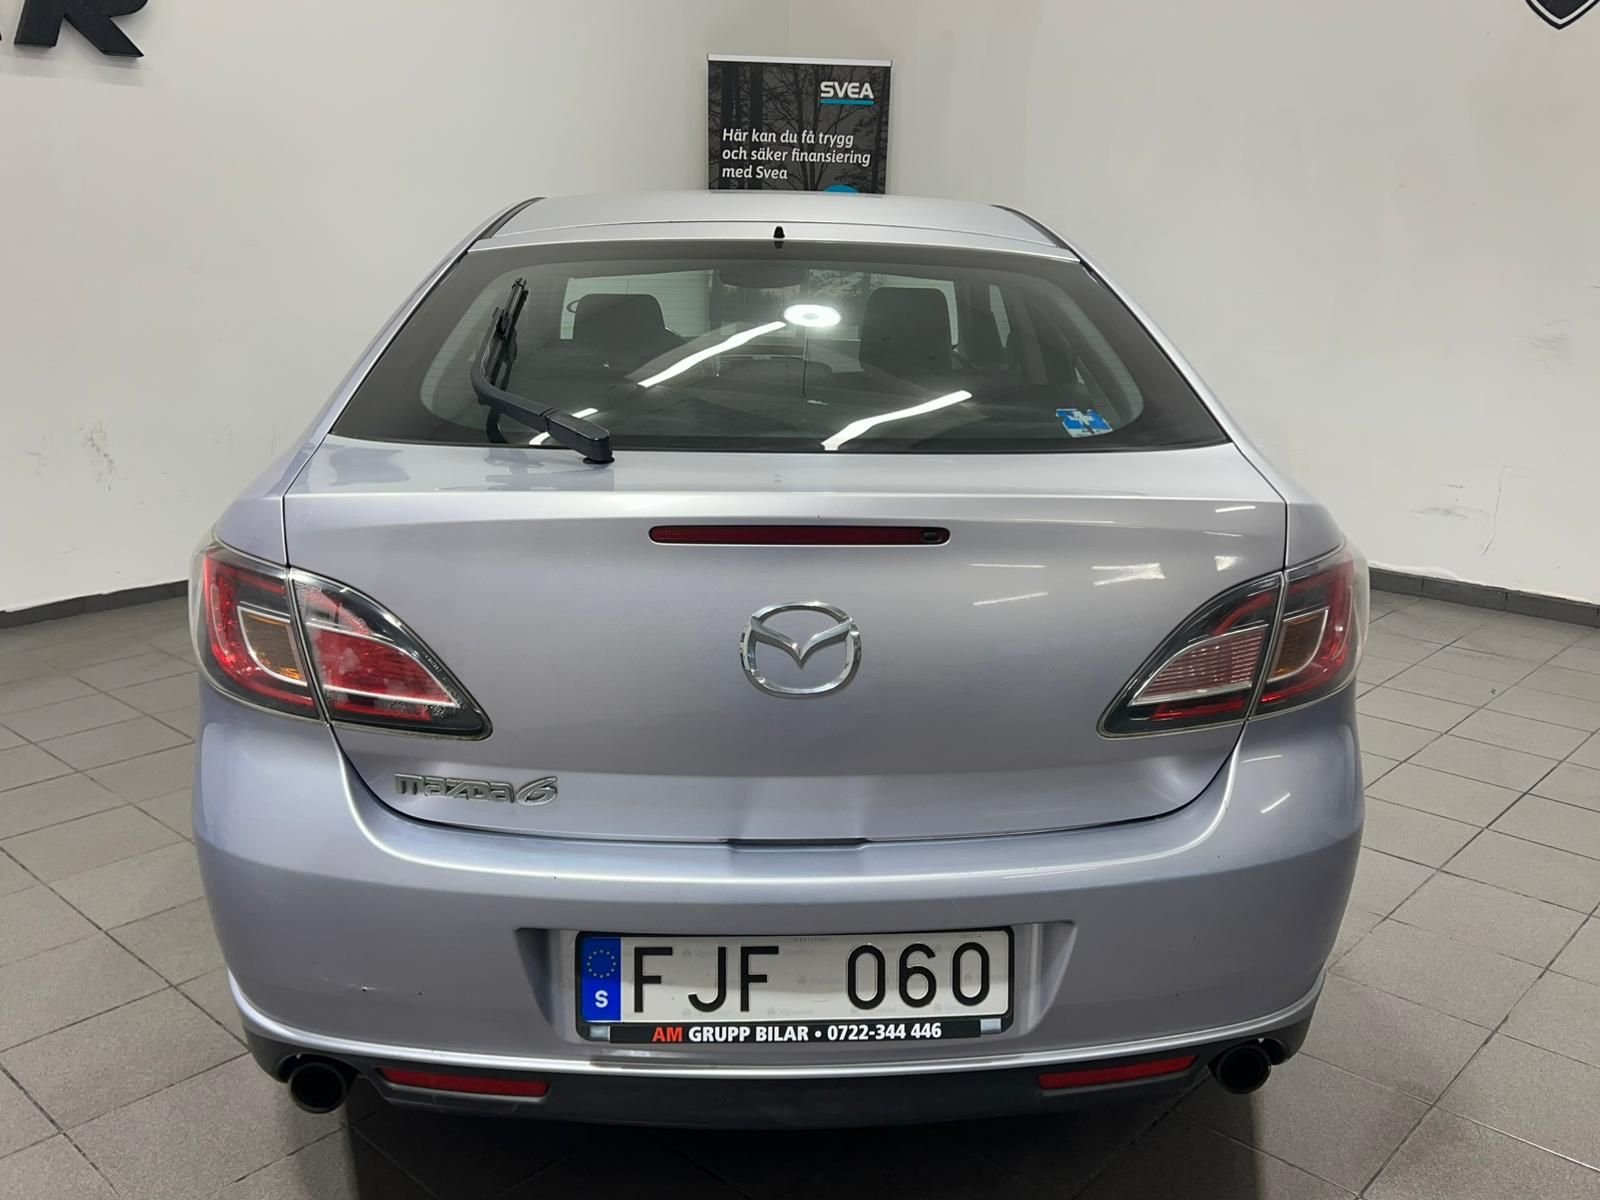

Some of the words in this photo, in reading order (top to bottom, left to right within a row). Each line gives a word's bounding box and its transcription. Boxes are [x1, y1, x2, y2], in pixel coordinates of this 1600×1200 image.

[820, 81, 875, 99] SVEA
[722, 128, 748, 142] Här
[751, 129, 777, 143] kan
[780, 130, 798, 144] du
[801, 130, 815, 145] få
[818, 132, 854, 148] trygg
[722, 147, 748, 160] och
[751, 148, 788, 162] säker
[791, 149, 871, 167] finansiering
[722, 165, 753, 178] med
[756, 166, 788, 180] Svea
[595, 990, 609, 1009] S
[634, 945, 779, 1014] FJF
[846, 941, 991, 1011] 060
[652, 1026, 683, 1043] AM
[688, 1025, 750, 1042] GRUPP
[755, 1025, 809, 1042] BILAR
[827, 1024, 906, 1041] 0722-344
[910, 1022, 942, 1038] 446
